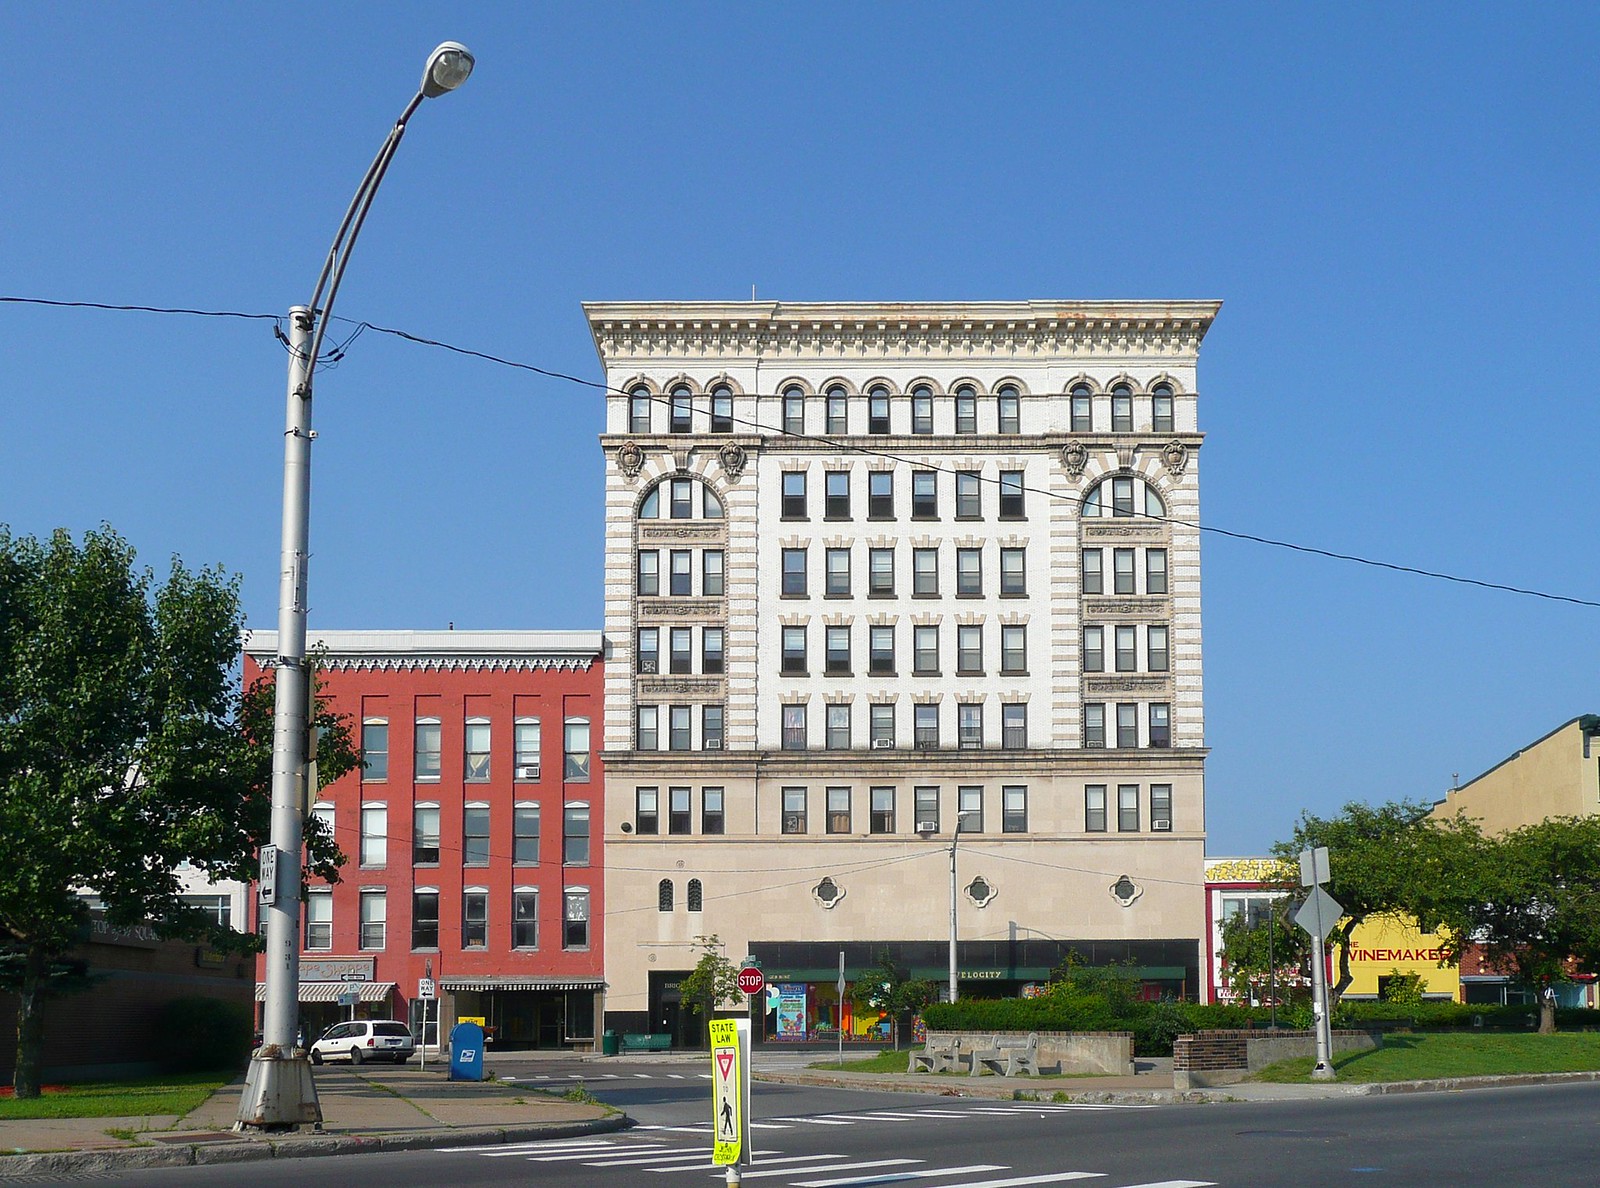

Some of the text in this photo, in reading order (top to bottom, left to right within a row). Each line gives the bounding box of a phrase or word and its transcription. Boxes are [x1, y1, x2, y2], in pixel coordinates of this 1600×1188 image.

[262, 850, 274, 865] ONE
[261, 866, 274, 881] WAY
[91, 920, 110, 934] TOP
[739, 975, 762, 986] STOP
[711, 1023, 734, 1033] STATE
[716, 1033, 731, 1044] LAW
